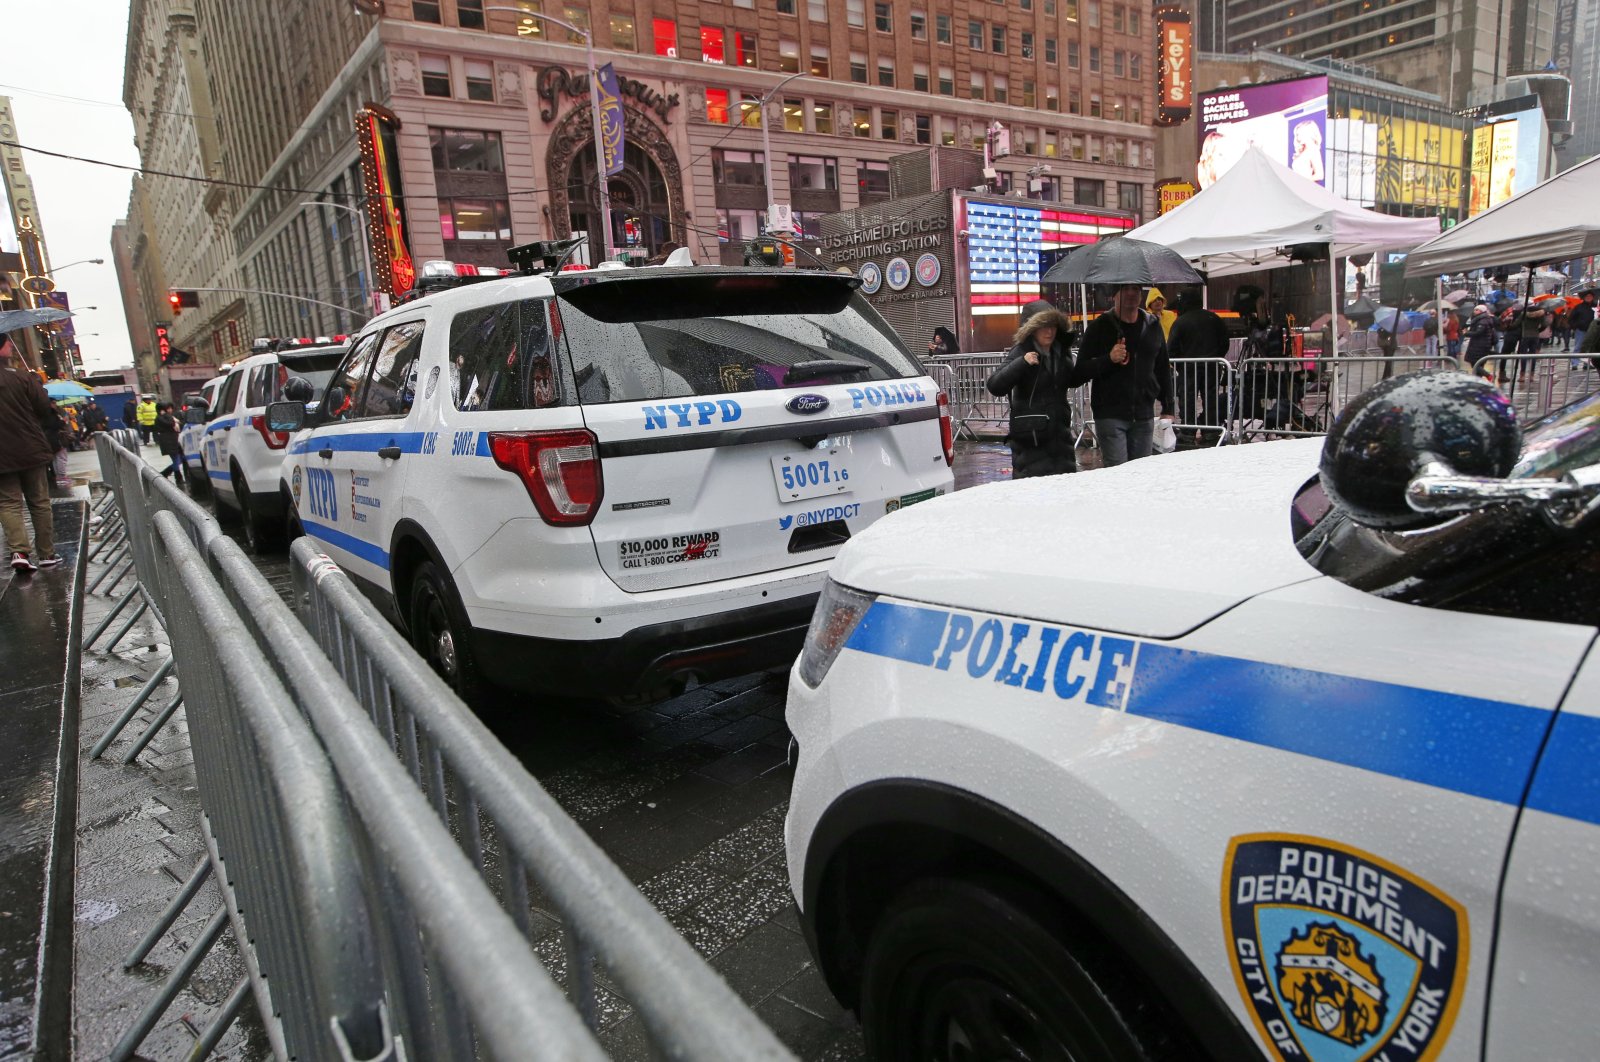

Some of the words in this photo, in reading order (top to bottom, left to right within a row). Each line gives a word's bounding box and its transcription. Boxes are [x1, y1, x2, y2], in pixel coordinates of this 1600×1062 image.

[1169, 29, 1184, 101] Levi's
[1203, 97, 1217, 106] GO
[1218, 93, 1240, 104] BARE
[1203, 101, 1245, 115] BACKLESS
[594, 69, 622, 169] Aladdin
[1203, 109, 1249, 123] STRAPLESS
[1163, 190, 1191, 202] BUBBA
[845, 224, 891, 246] ARMED
[892, 216, 947, 238] FORCES
[831, 242, 891, 263] RECRUITING
[893, 234, 940, 253] STATION
[156, 328, 169, 361] PAR
[797, 396, 827, 409] Ford
[846, 382, 926, 409] POLICE
[641, 399, 742, 430] NYPD
[782, 460, 831, 489] 5007
[833, 468, 849, 482] 16
[306, 467, 338, 521] NYPD
[797, 503, 860, 526] @NYPDCT
[620, 538, 669, 556] $10,000
[672, 531, 720, 548] REWARD
[623, 559, 642, 569] CALL
[644, 556, 665, 567] 1-800
[935, 613, 1136, 711] POLICE
[1279, 847, 1403, 911] POLICE
[1237, 874, 1447, 969] DEPARTMENT
[1236, 938, 1274, 1006] CITY
[1266, 1018, 1301, 1055] OF
[1392, 983, 1445, 1054] YORK
